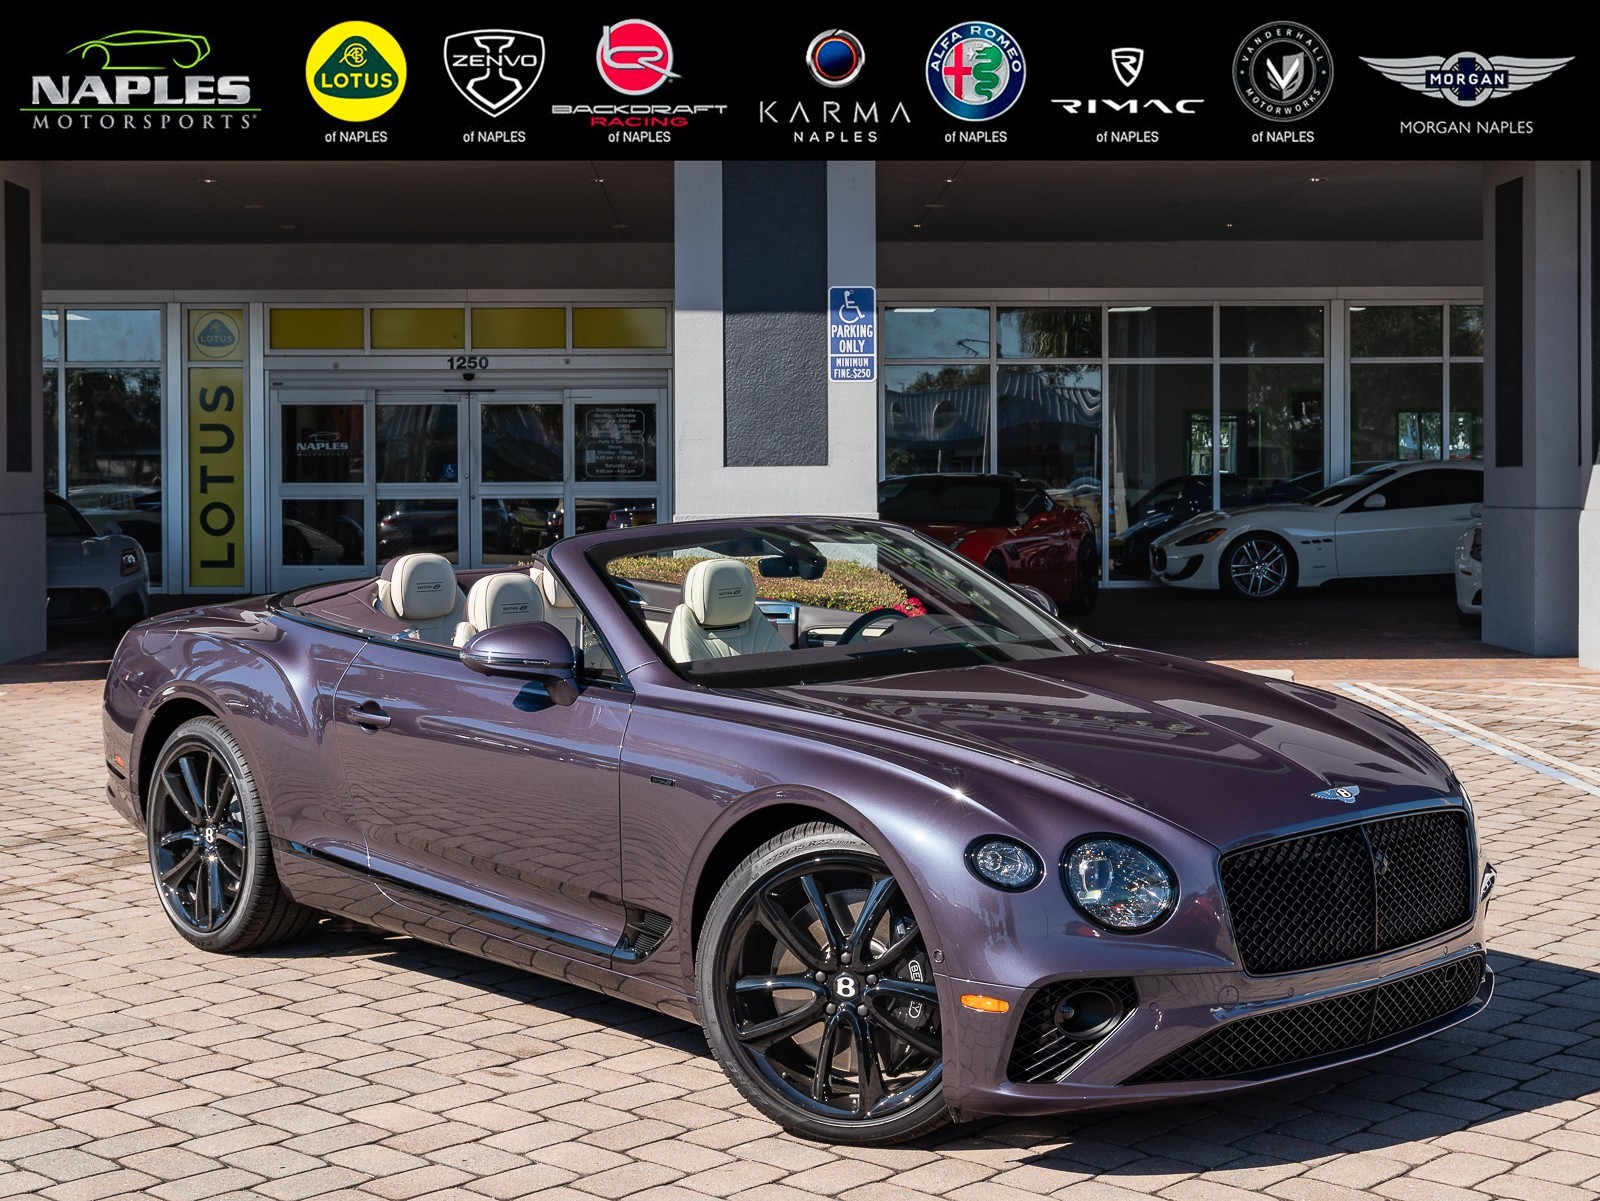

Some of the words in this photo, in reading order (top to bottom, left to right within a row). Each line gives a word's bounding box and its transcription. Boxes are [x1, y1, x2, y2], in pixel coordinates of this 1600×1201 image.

[831, 324, 873, 338] PARKING
[200, 335, 233, 343] LOTUS
[839, 339, 865, 353] ONLY
[447, 355, 489, 370] 1250
[836, 357, 869, 367] MINIMUM
[834, 368, 851, 378] FINE
[852, 367, 871, 379] $250
[296, 442, 349, 451] NAPLES
[199, 385, 235, 569] LOTUS
